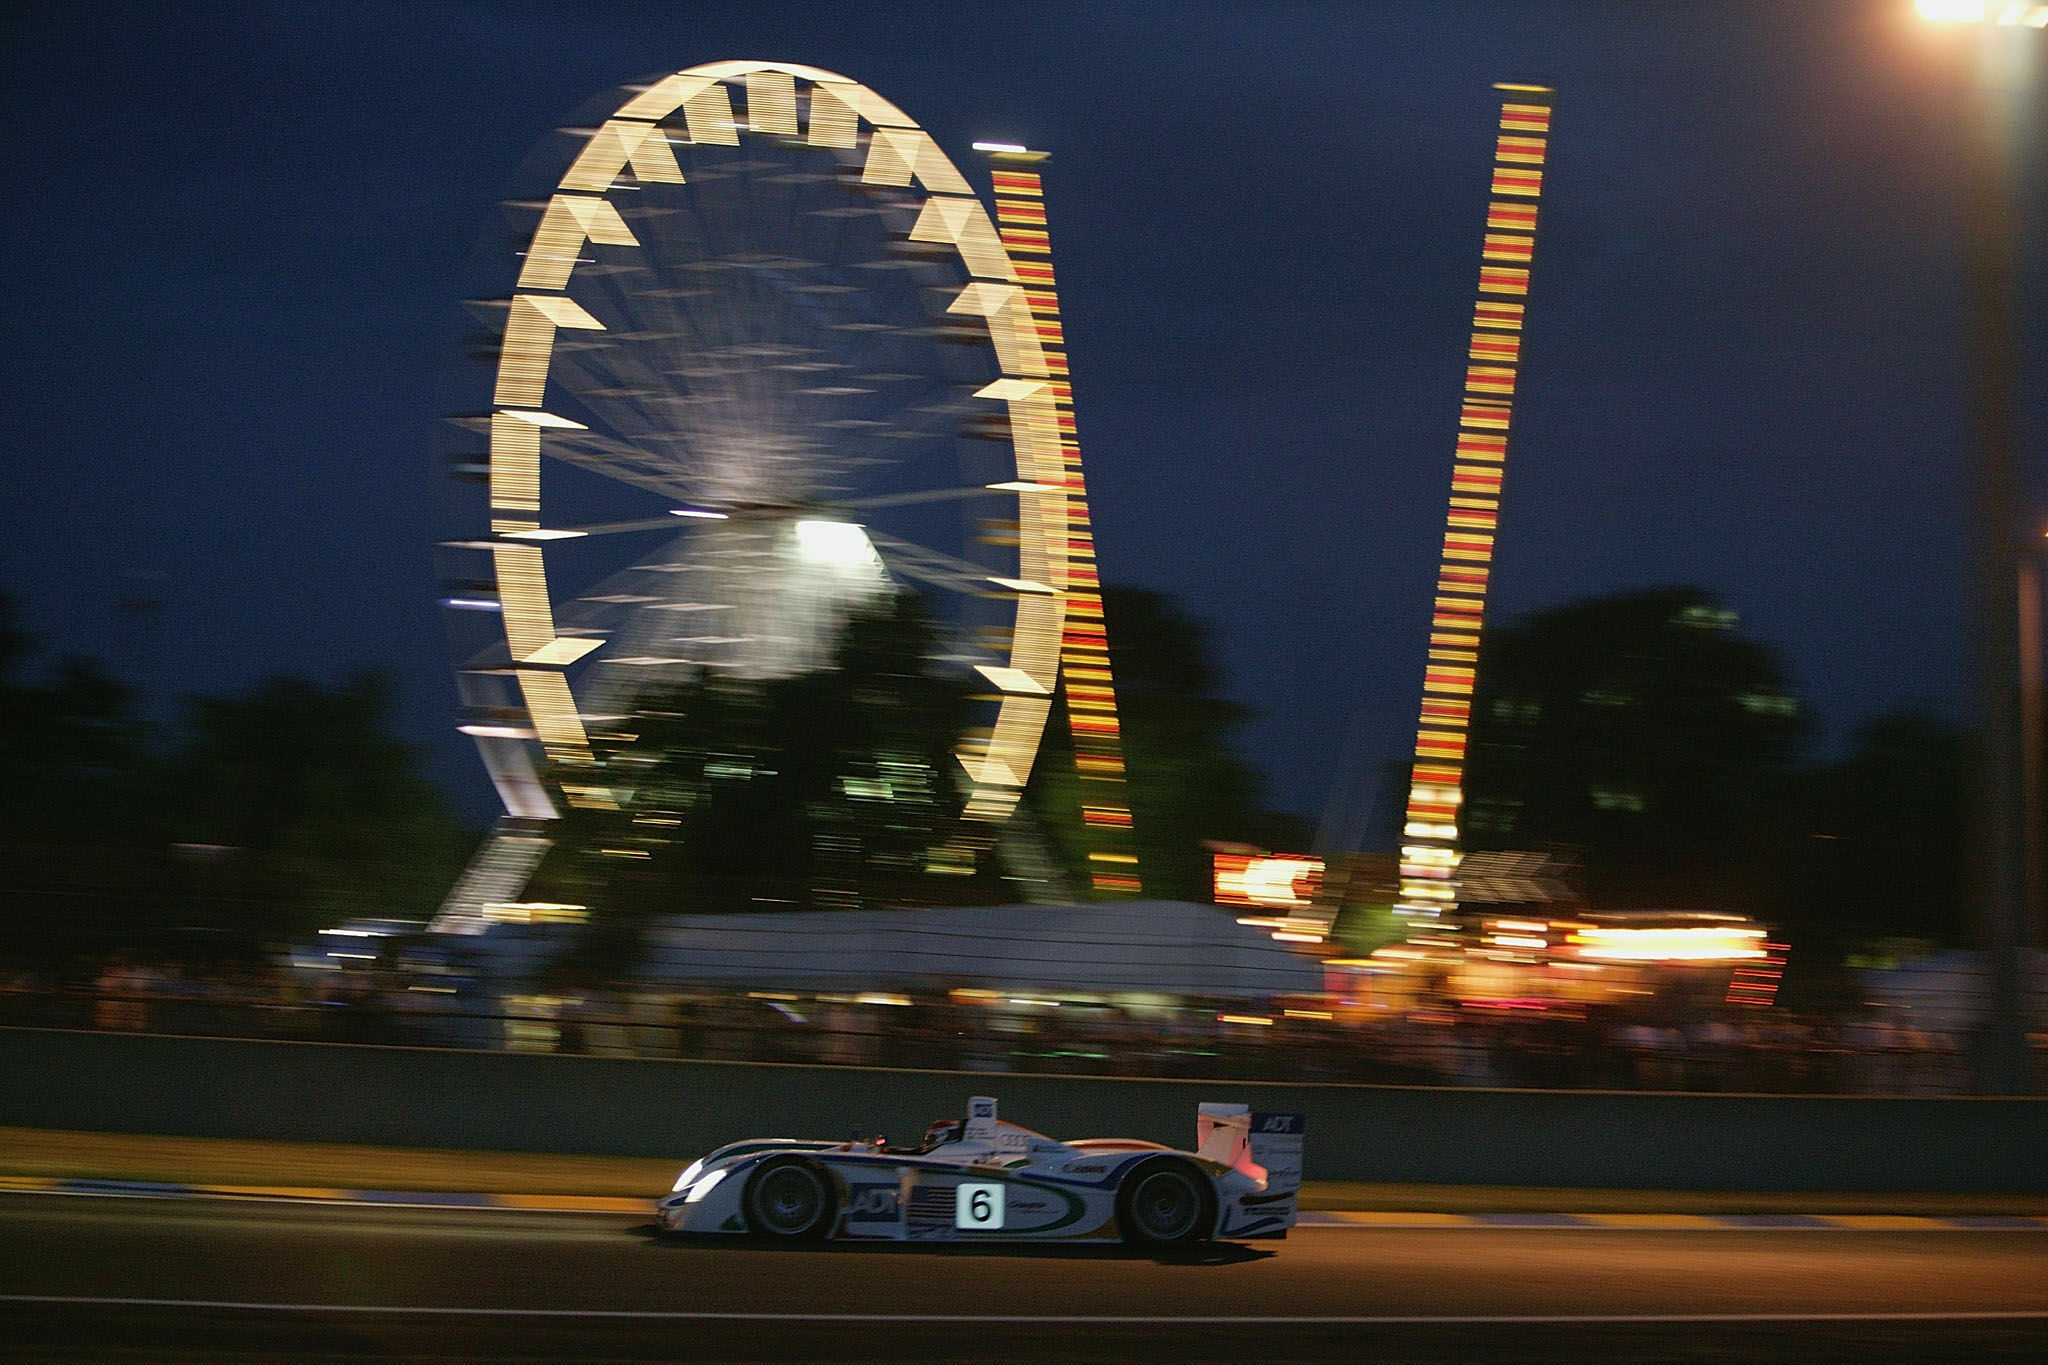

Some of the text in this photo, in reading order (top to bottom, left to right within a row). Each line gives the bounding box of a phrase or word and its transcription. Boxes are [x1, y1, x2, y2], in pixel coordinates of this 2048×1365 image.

[1261, 1115, 1295, 1132] ADT
[848, 1188, 898, 1214] ADT
[971, 1189, 992, 1223] 6
